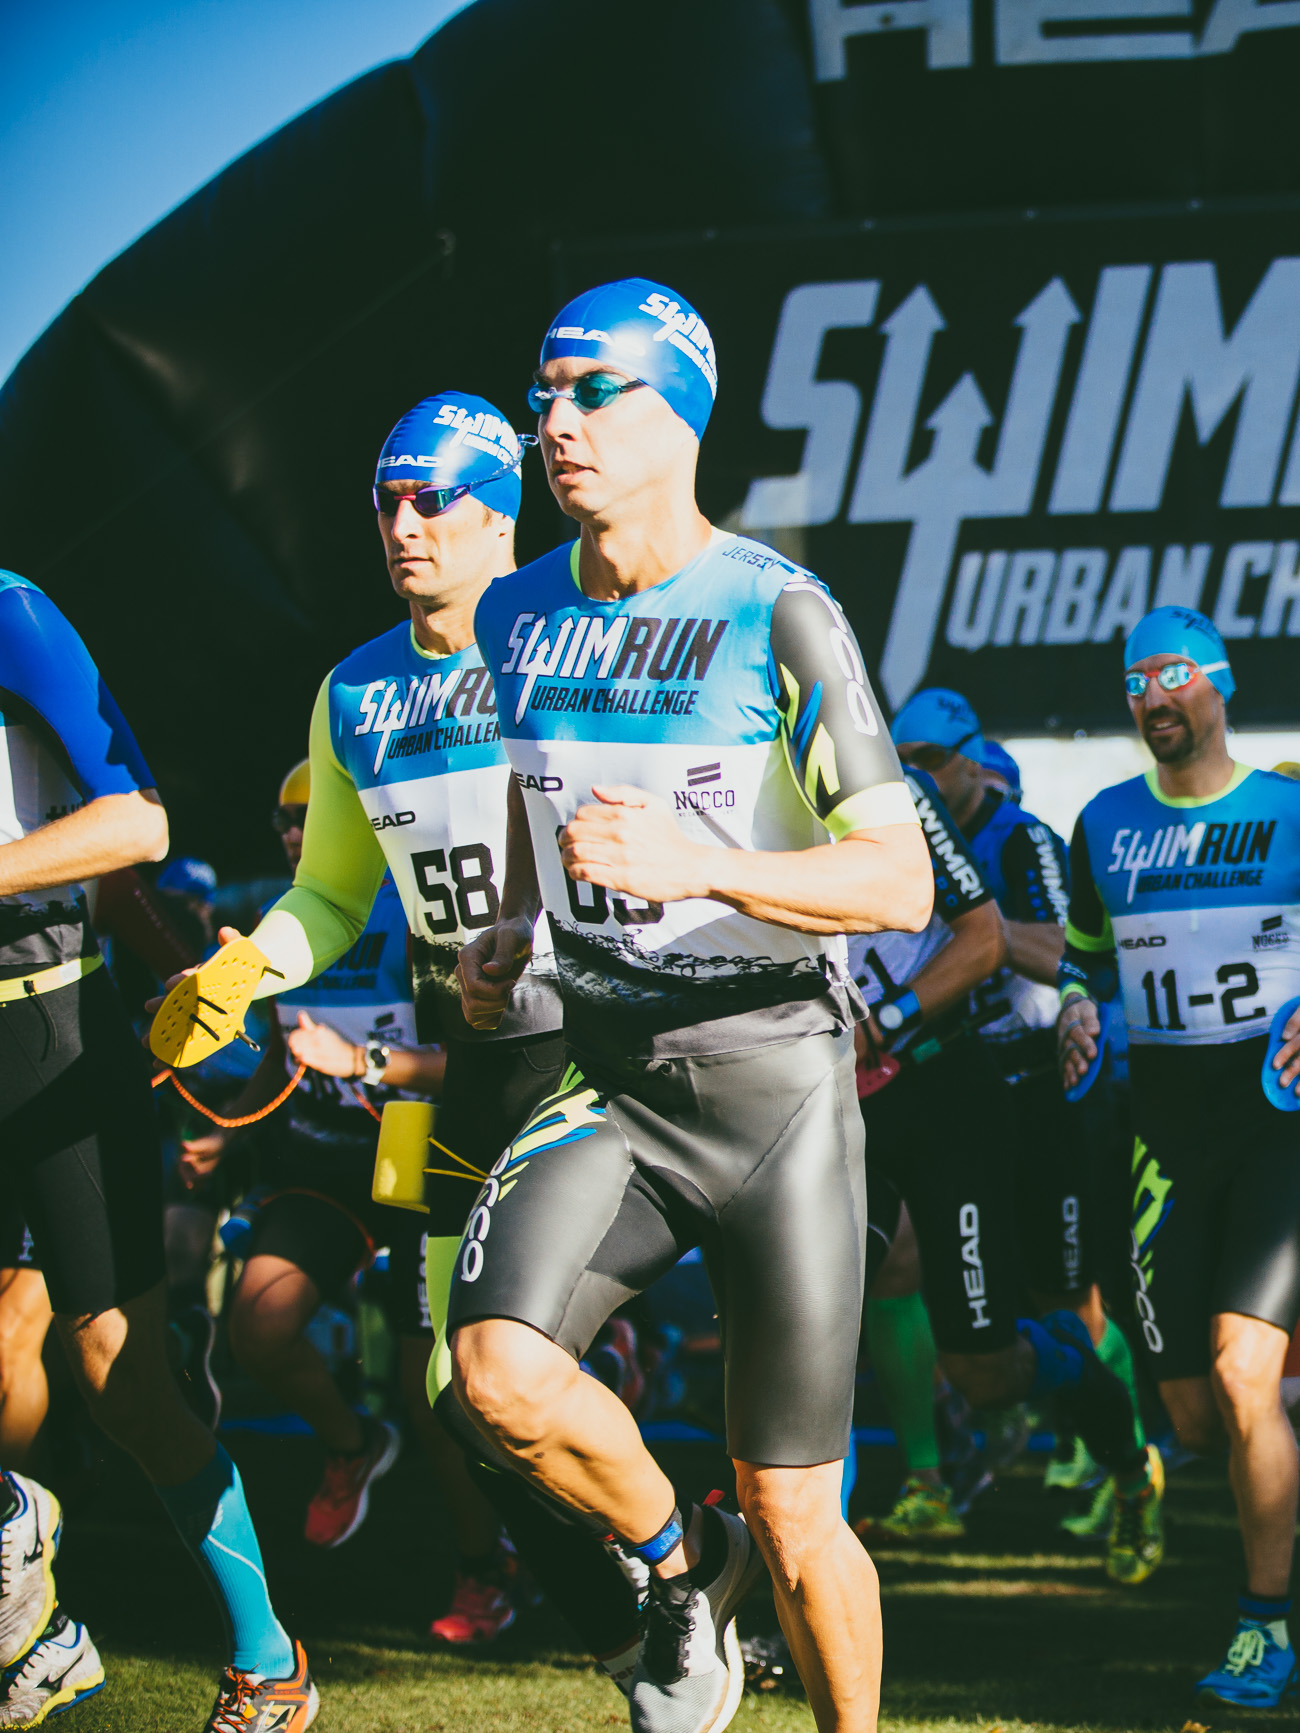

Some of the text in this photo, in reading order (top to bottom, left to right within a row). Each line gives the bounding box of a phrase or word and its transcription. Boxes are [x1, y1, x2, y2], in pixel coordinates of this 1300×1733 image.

[378, 454, 443, 469] EAD
[946, 543, 1213, 652] URBAN
[501, 612, 730, 728] SWIMRUN
[530, 685, 700, 716] URBAN CHALLENGE
[355, 667, 499, 777] SWIMRU
[387, 721, 501, 760] URBAN CHALLEN
[370, 811, 416, 831] EAD
[516, 773, 563, 792] EAD
[673, 789, 735, 810] NOCCO
[410, 842, 501, 935] 58
[1107, 820, 1277, 905] SWIMRUN
[1141, 962, 1267, 1031] 11-2
[959, 1203, 991, 1329] HEAD
[1063, 1196, 1081, 1290] HEAD
